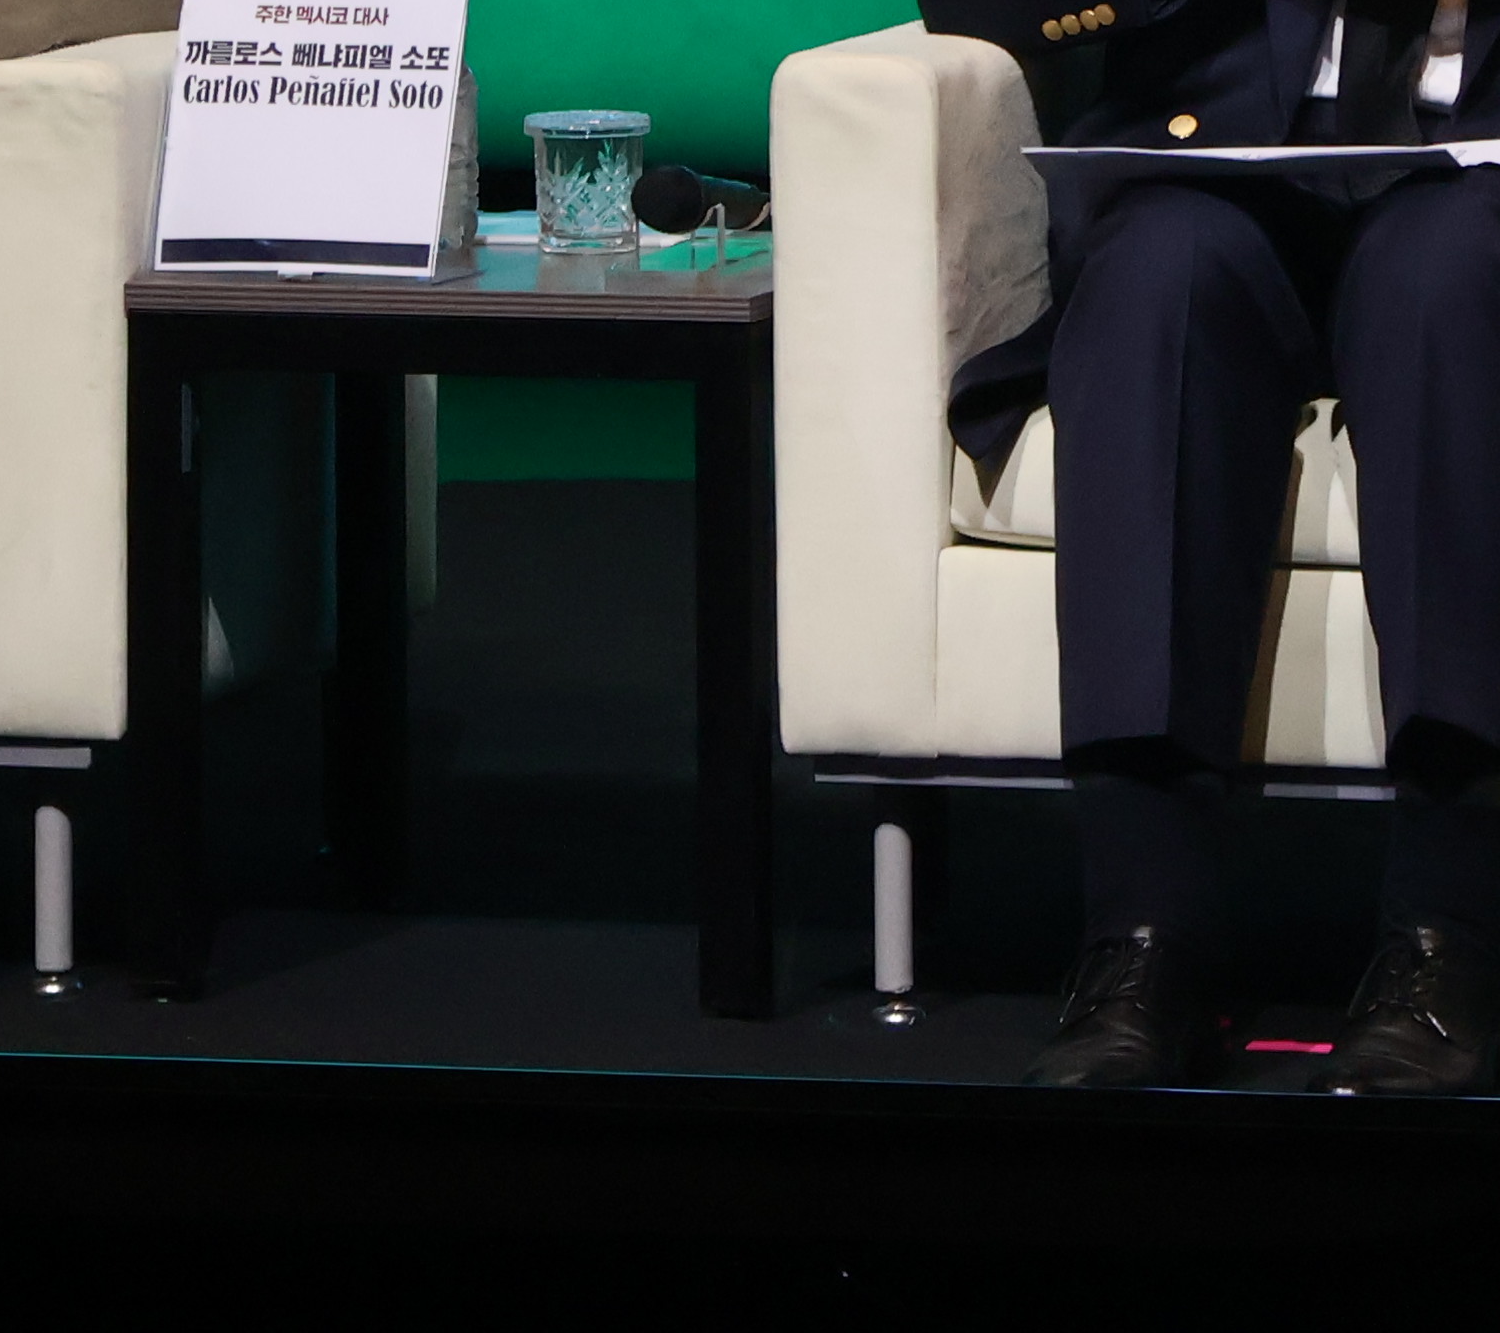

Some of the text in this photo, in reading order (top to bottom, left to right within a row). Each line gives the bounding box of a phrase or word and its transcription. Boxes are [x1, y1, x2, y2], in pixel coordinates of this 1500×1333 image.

[255, 4, 389, 26] 주한 멕시코 대사
[185, 40, 450, 71] 까를로스 뻬냐피엘 소또
[183, 74, 444, 110] Carlos Peñafiel Soto
